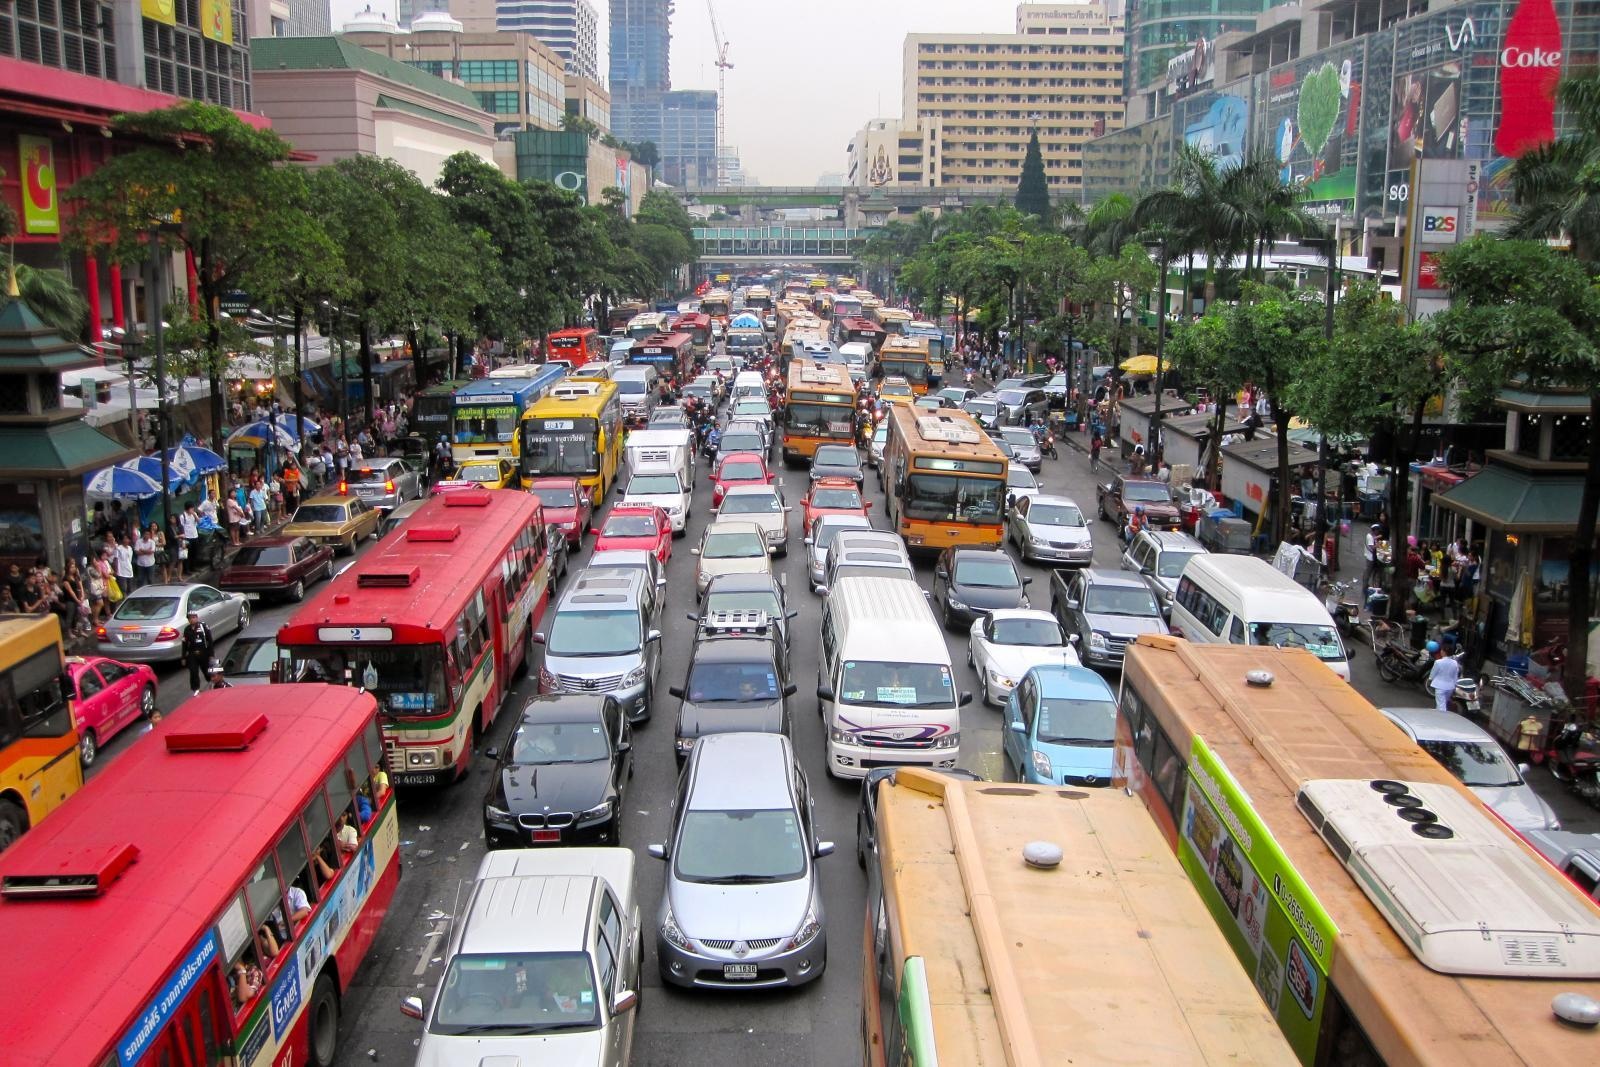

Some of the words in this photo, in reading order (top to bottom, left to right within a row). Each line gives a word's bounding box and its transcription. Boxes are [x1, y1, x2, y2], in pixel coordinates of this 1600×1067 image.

[1500, 47, 1561, 68] Coke
[1389, 184, 1409, 201] SO
[1424, 216, 1455, 232] B2S
[350, 628, 361, 640] 2
[1281, 884, 1324, 958] 0-2656-5030
